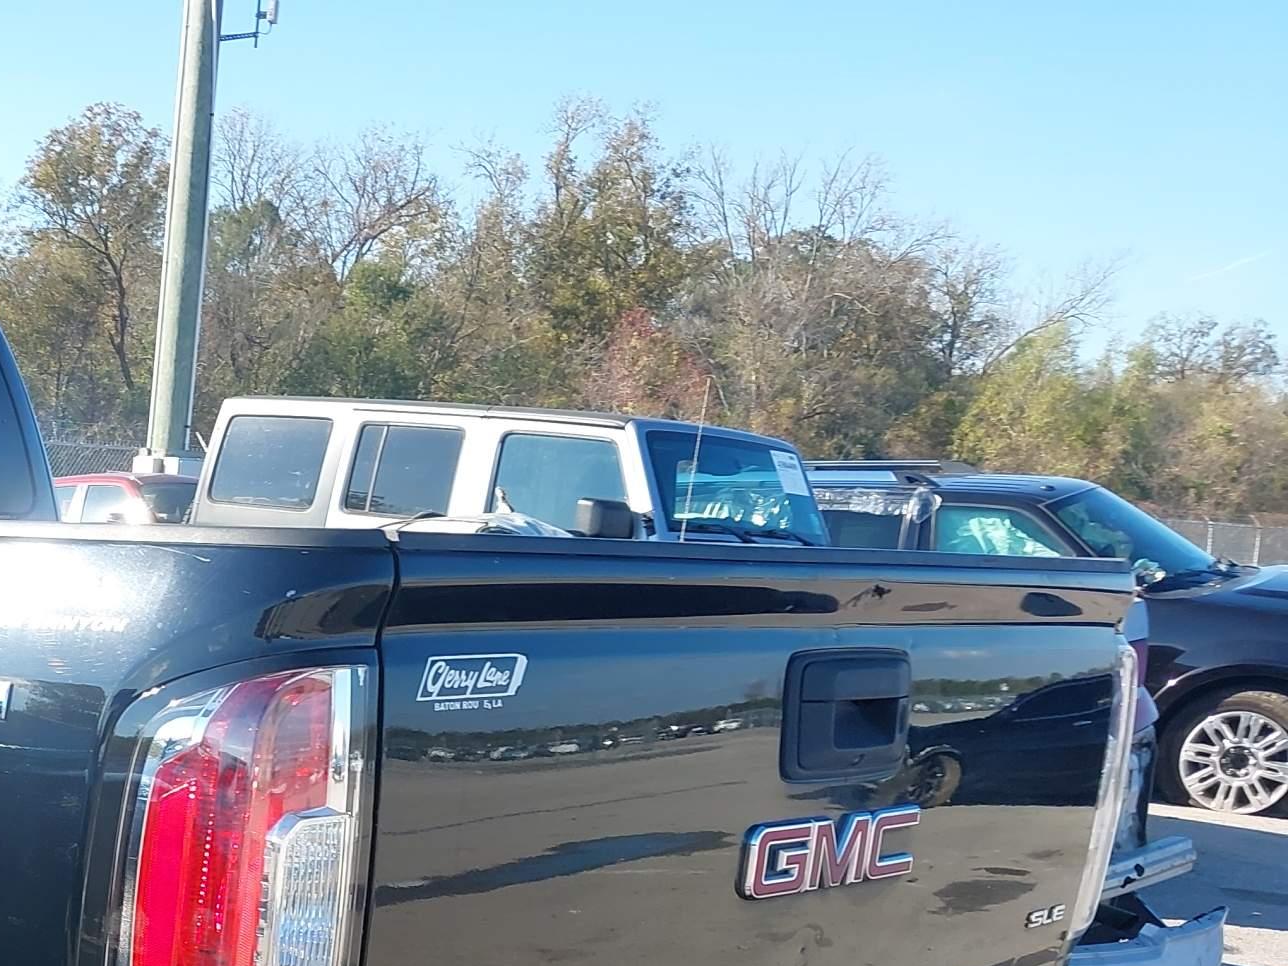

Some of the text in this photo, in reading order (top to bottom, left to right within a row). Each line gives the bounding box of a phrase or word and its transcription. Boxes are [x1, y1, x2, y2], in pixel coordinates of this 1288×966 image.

[477, 661, 510, 688] Lane
[434, 700, 461, 711] BATON
[734, 803, 921, 900] GMC
[1024, 903, 1066, 929] SLE
